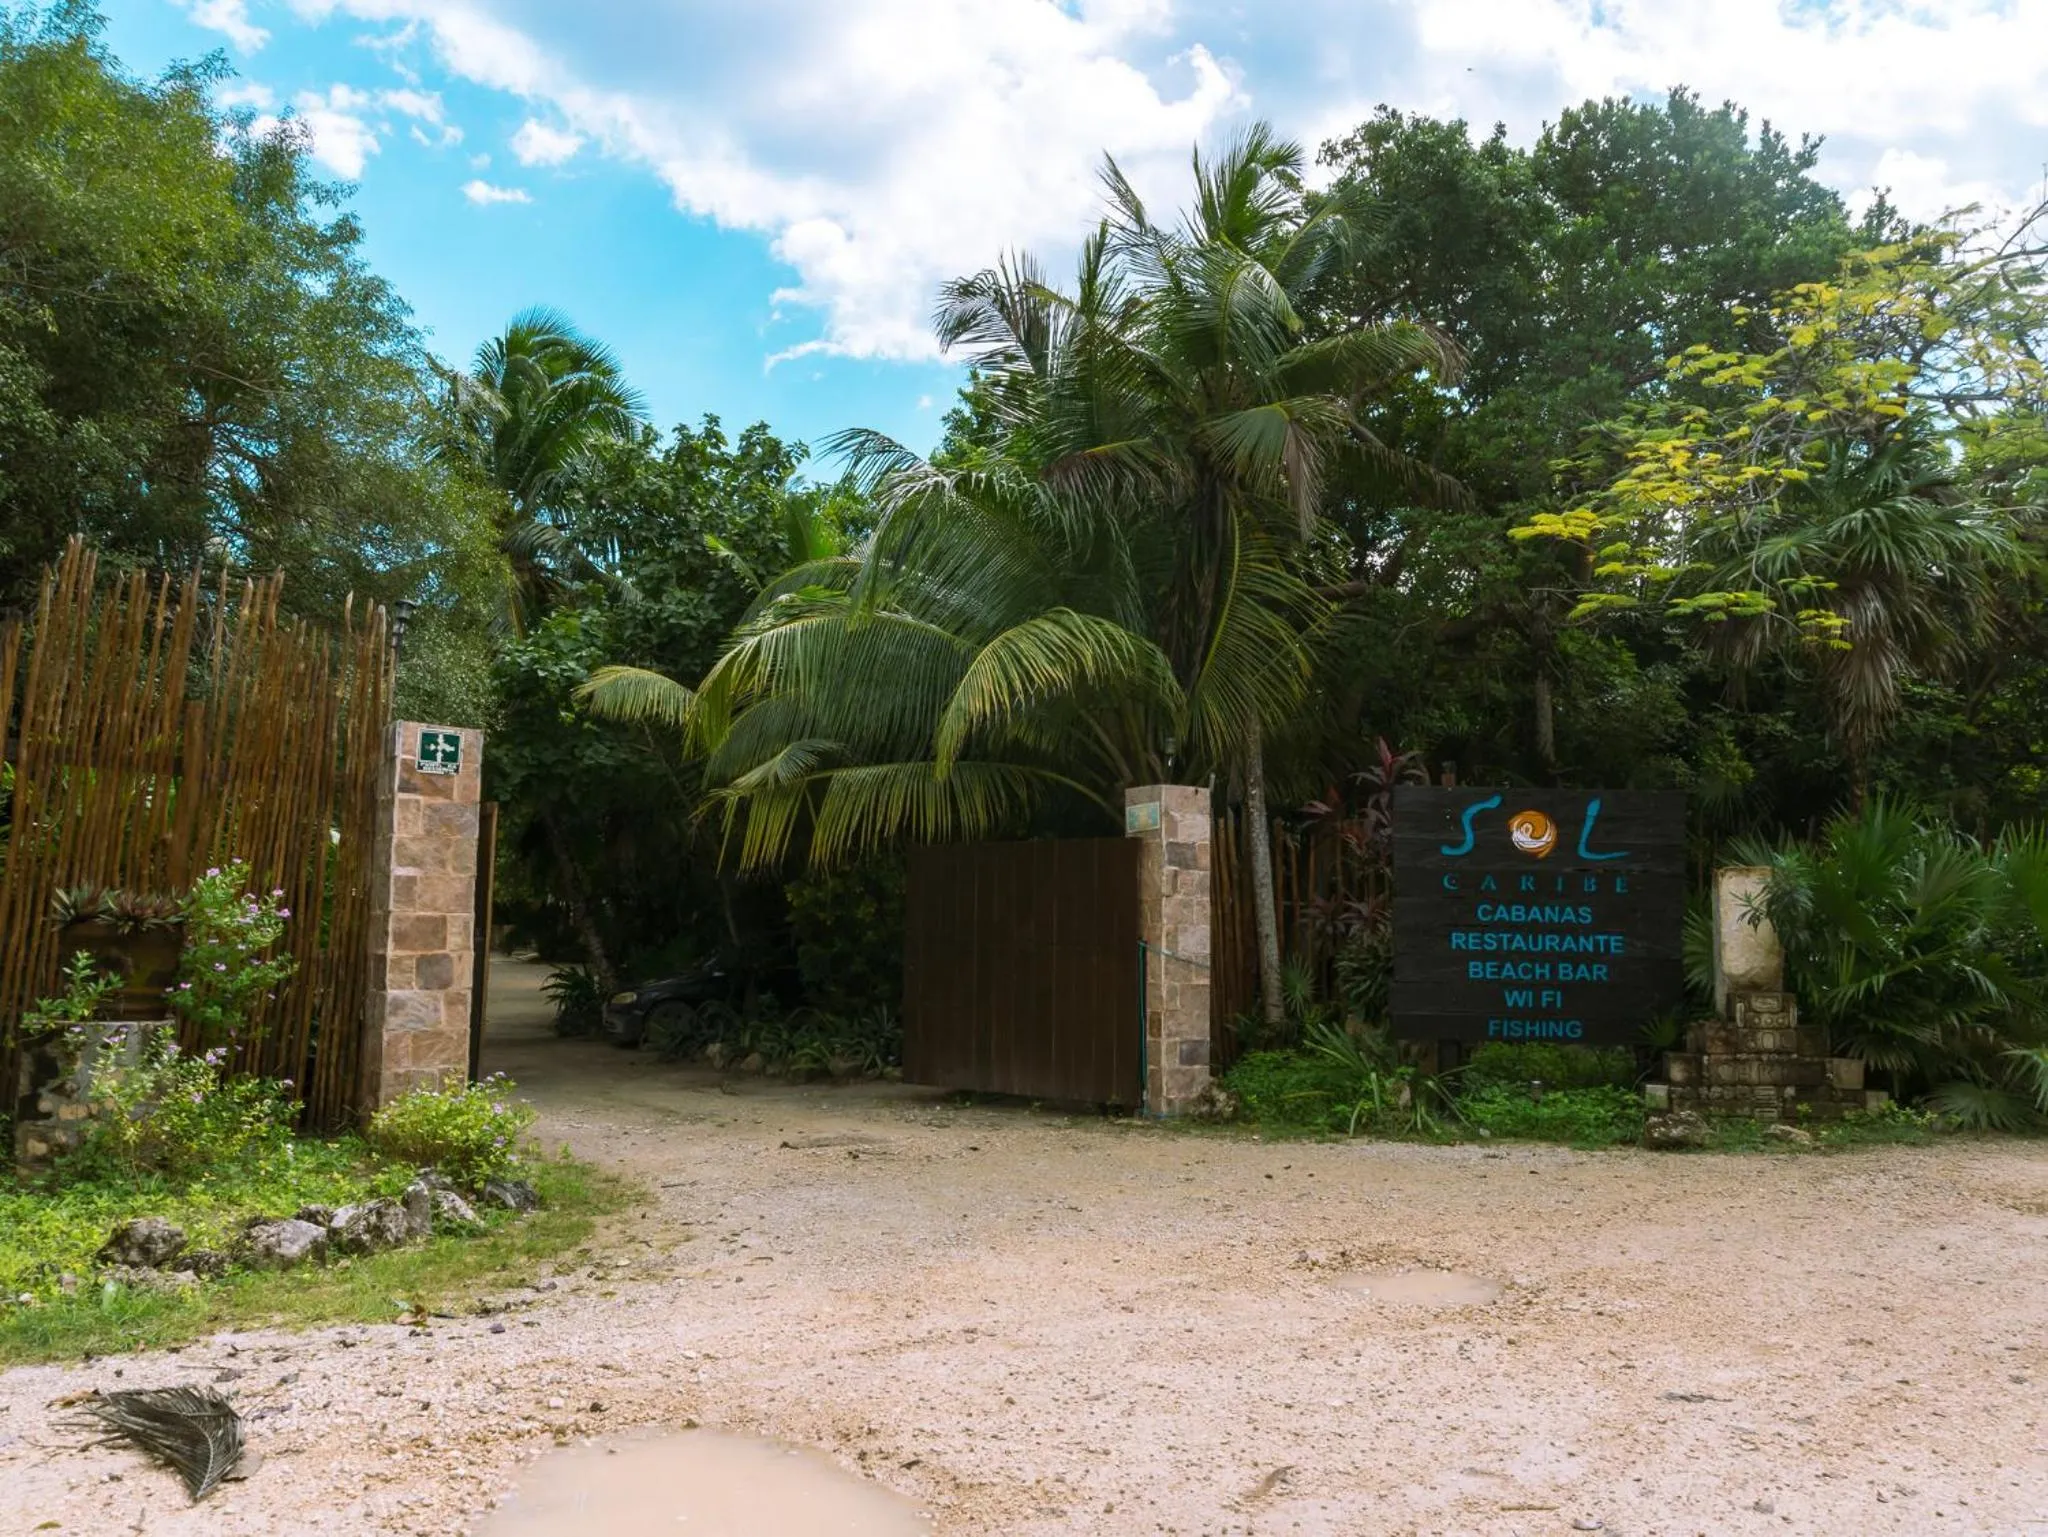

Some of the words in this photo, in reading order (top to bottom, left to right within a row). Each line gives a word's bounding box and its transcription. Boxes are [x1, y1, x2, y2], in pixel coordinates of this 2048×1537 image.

[1442, 873, 1629, 893] CARIBE
[1476, 904, 1593, 924] CABANAS
[1451, 932, 1625, 954] RESTAURANTE
[1468, 961, 1550, 981] BEACH
[1558, 963, 1608, 982] BAR
[1504, 990, 1533, 1008] WI
[1541, 991, 1562, 1010] FI
[1488, 1020, 1583, 1039] FISHING
